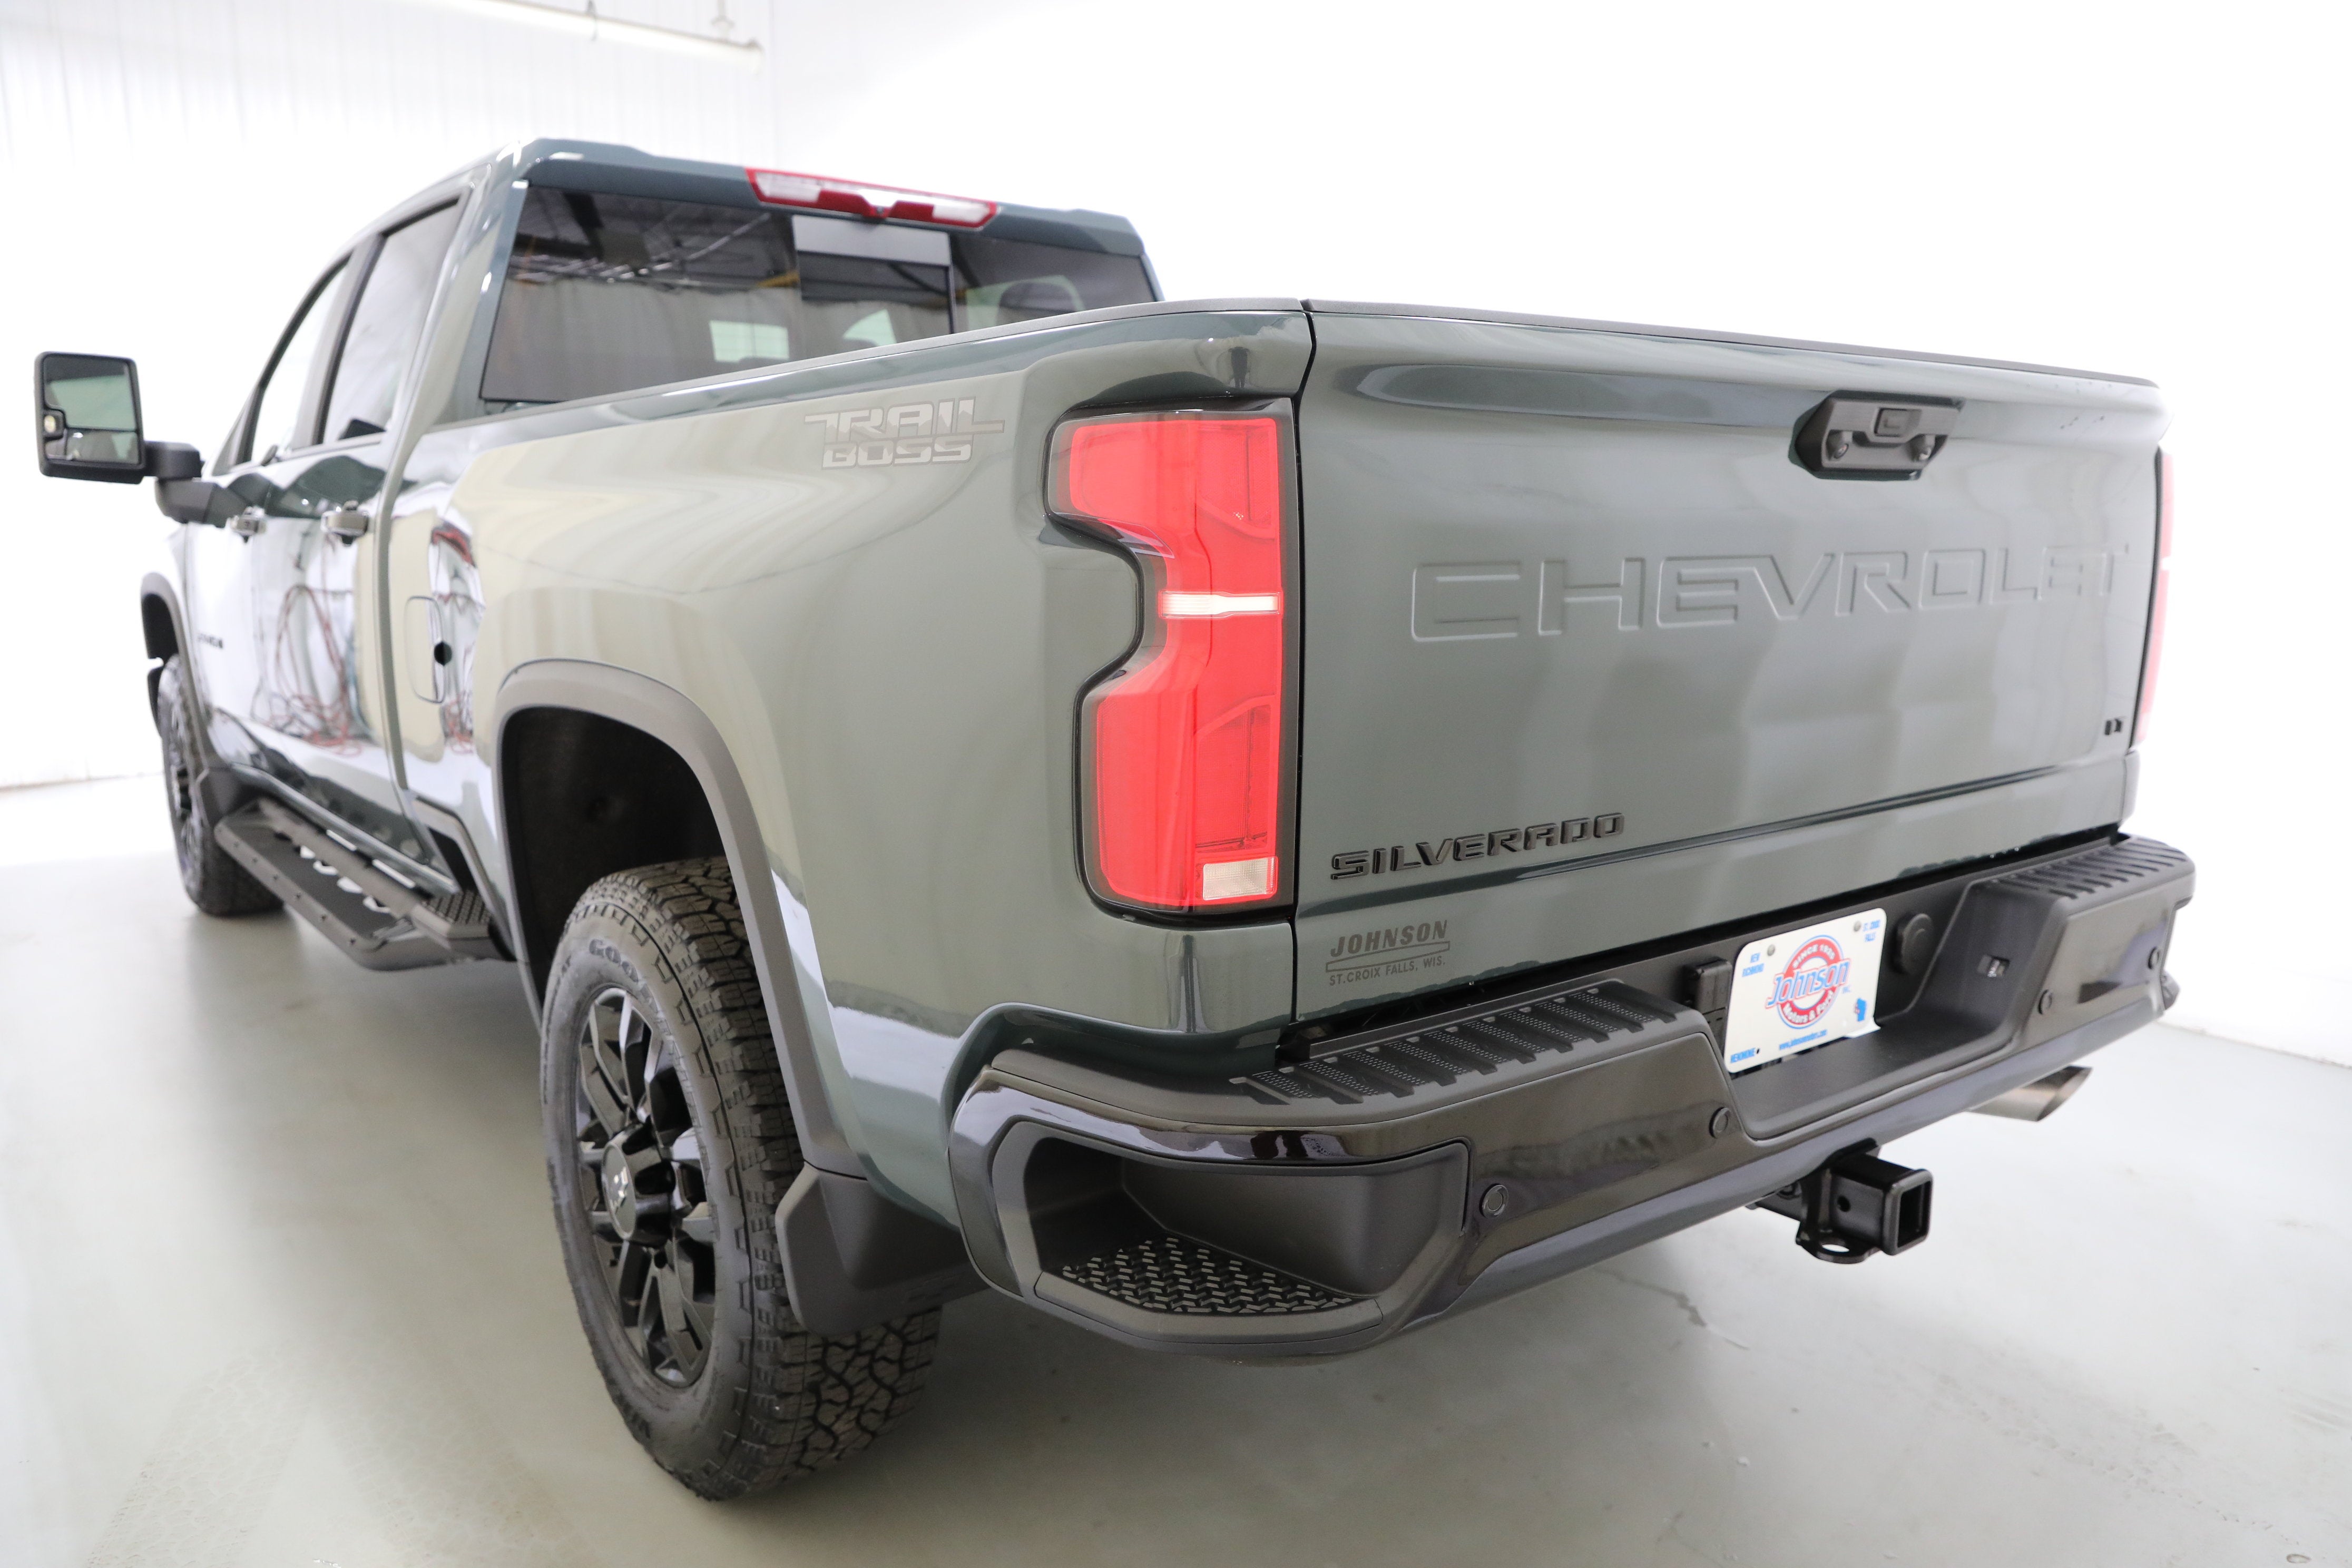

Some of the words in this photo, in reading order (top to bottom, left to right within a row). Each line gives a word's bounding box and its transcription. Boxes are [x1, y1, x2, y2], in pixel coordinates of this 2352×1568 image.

[805, 396, 1005, 443] TRAIL
[821, 433, 975, 470] BOSS
[1412, 544, 2129, 642] CHEVROLET
[1330, 812, 1625, 880] SILVERADO
[1330, 919, 1447, 957] JOHNSON
[1792, 944, 1818, 968] SINCE
[1386, 961, 1418, 976] FALLS,
[1424, 955, 1446, 968] WIS.
[1767, 959, 1850, 1007] Johnson
